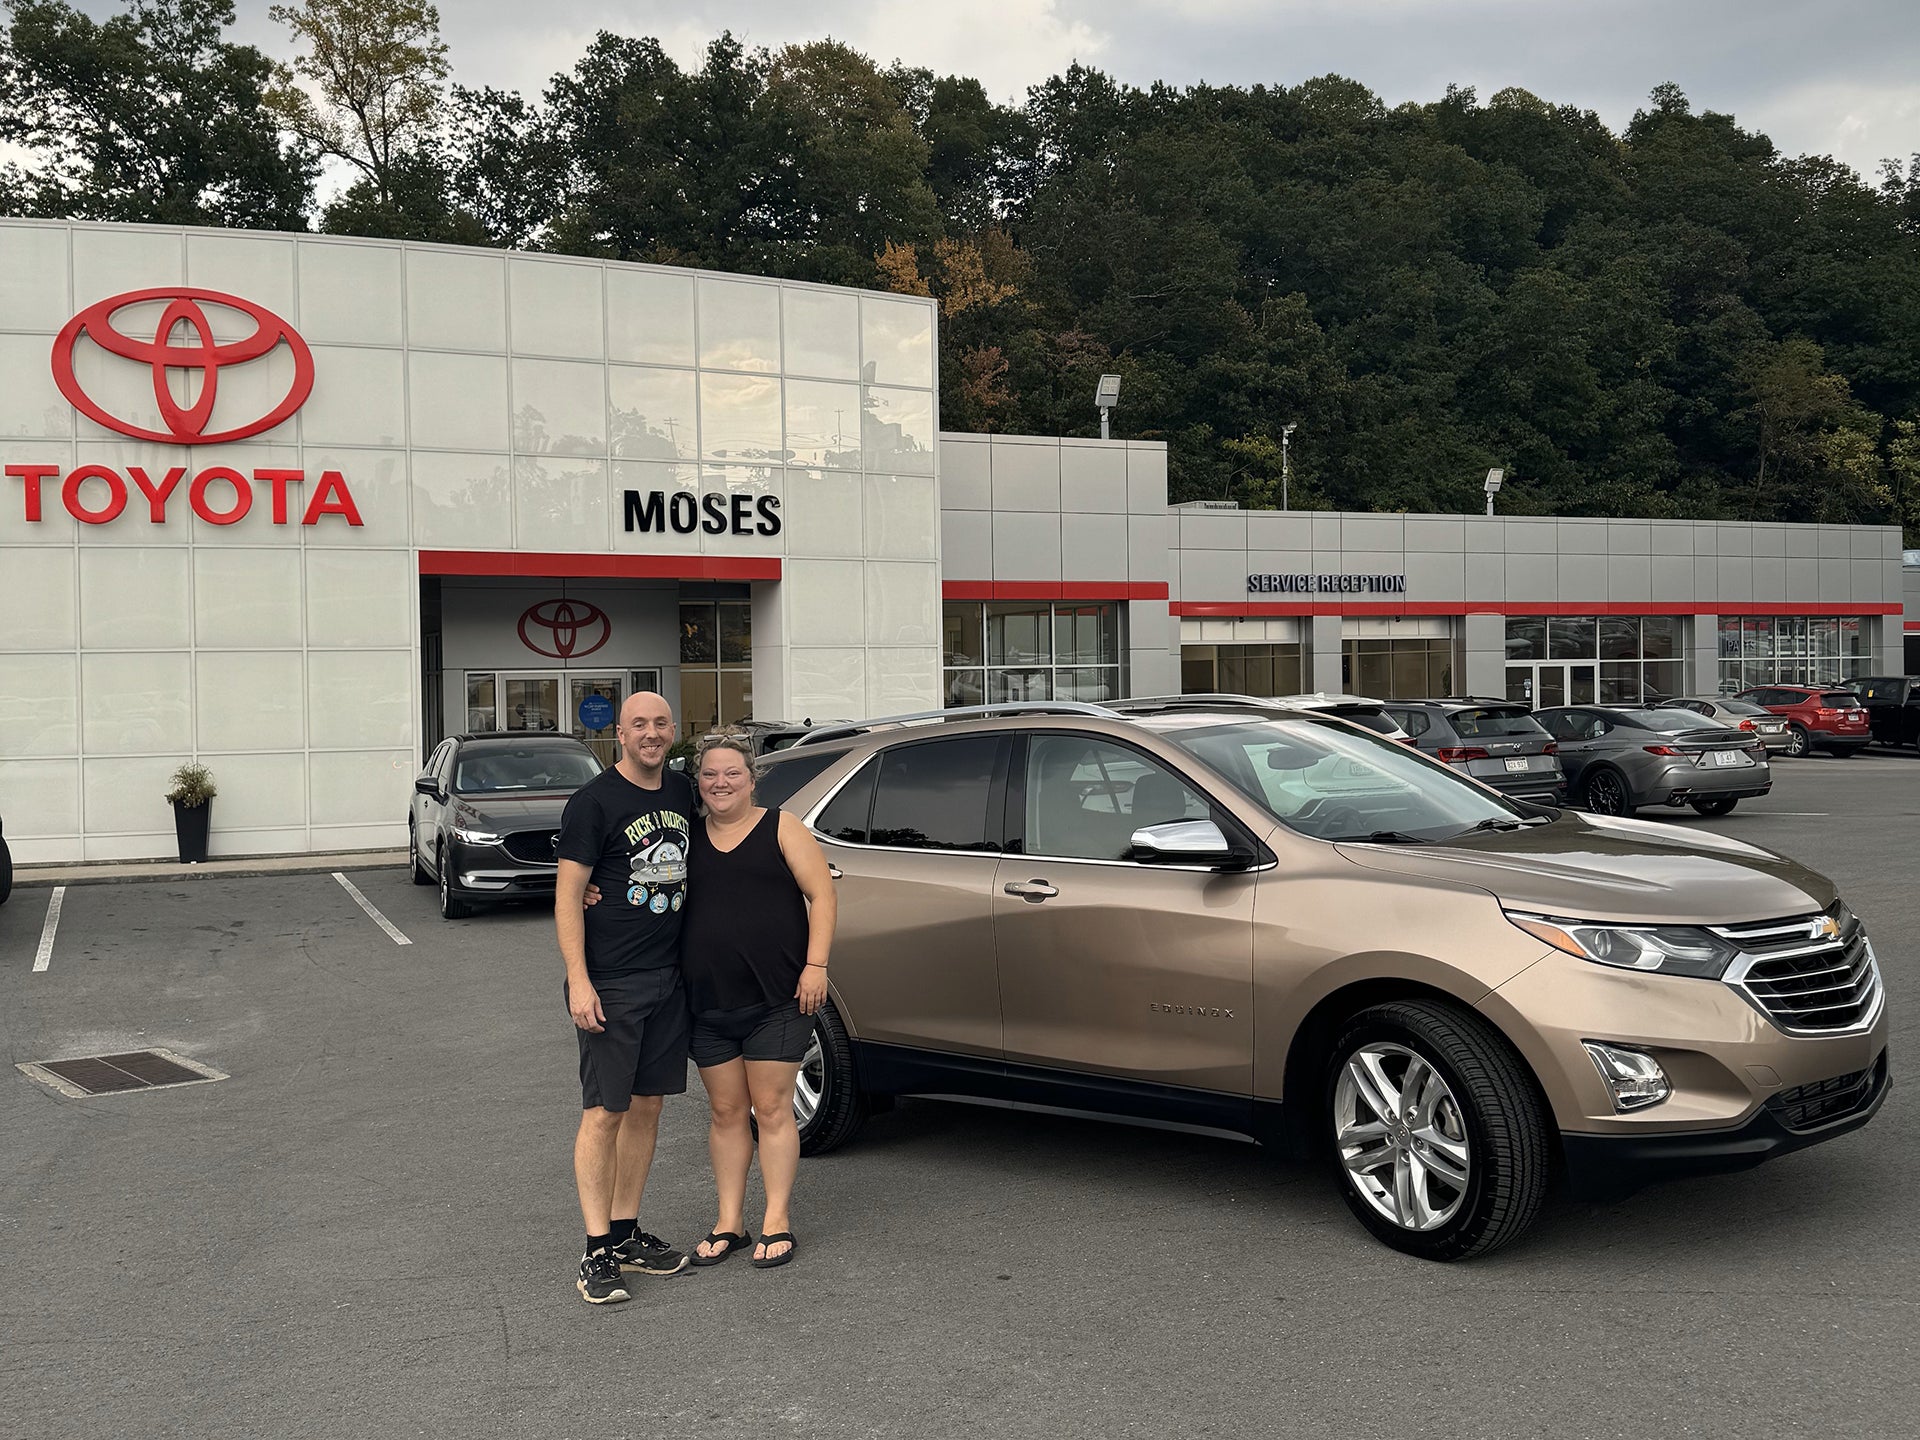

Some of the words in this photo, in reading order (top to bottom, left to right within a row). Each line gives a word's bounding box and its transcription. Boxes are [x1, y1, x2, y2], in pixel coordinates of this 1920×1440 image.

[4, 464, 365, 527] TOYOTA
[623, 489, 782, 536] MOSES
[1248, 574, 1317, 593] SERVICE
[1318, 574, 1407, 593] RECEPTION
[1727, 639, 1756, 652] PATS
[624, 813, 656, 846] RICK
[1150, 1003, 1234, 1018] EQUINOX
